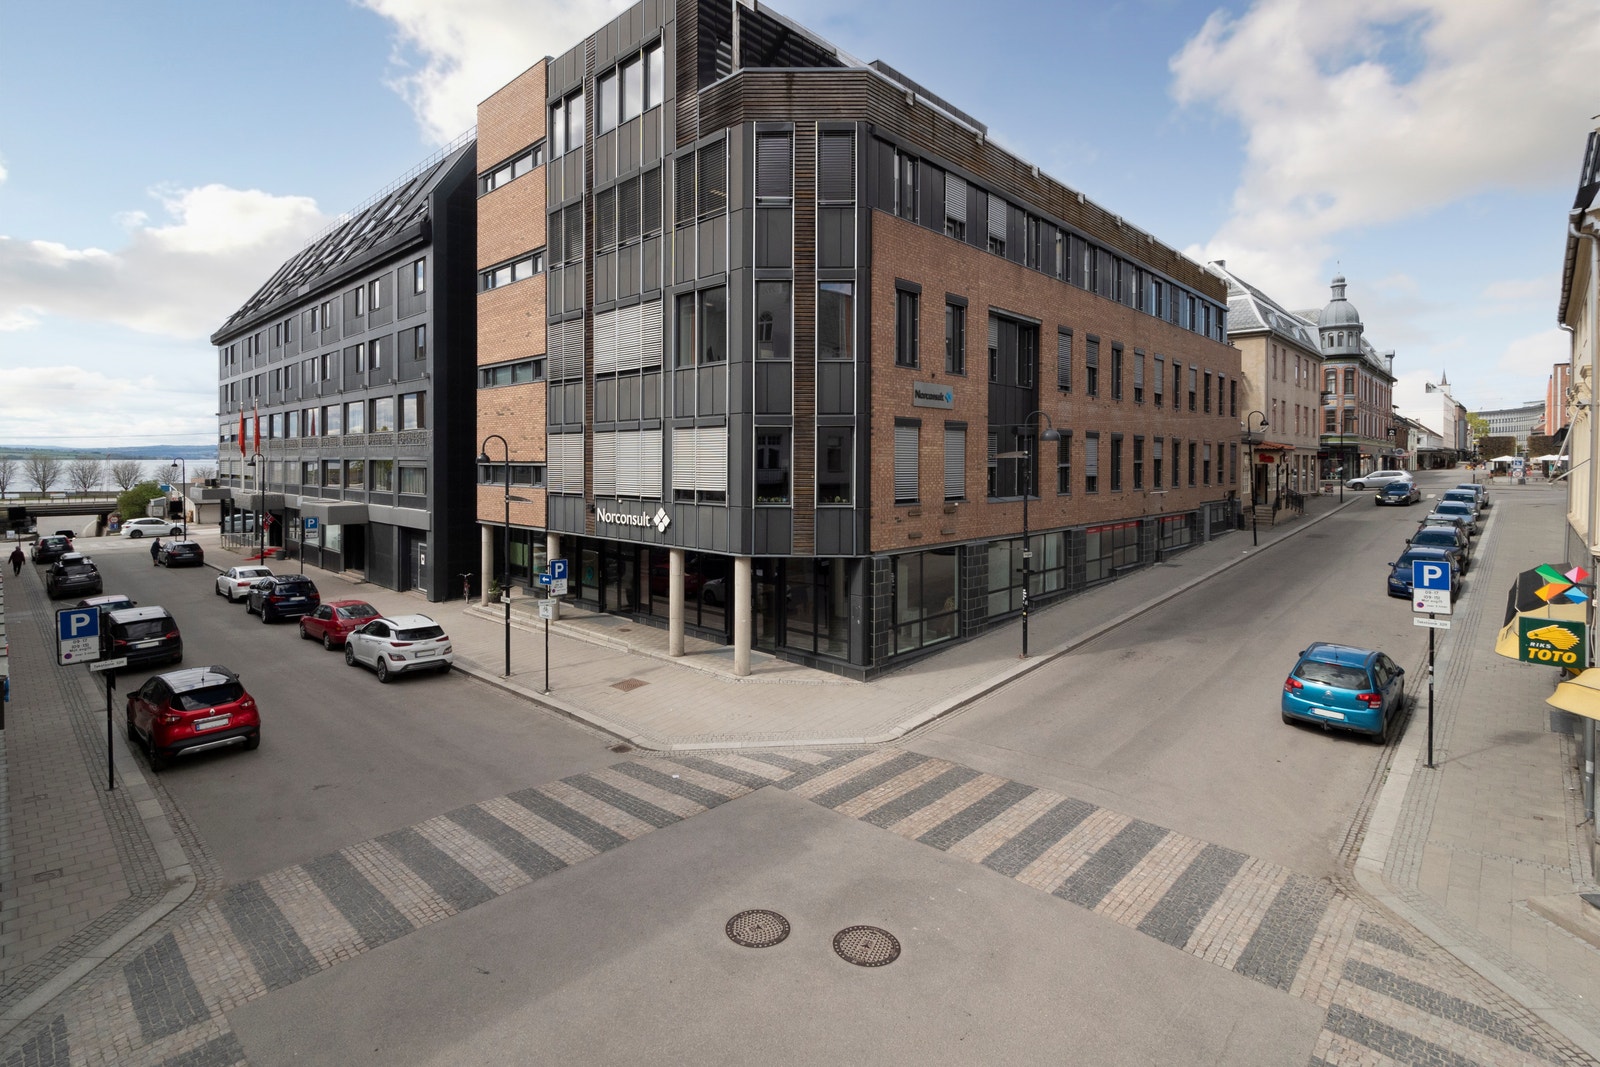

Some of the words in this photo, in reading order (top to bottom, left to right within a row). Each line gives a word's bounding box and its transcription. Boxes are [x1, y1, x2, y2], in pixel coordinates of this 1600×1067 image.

[308, 519, 315, 527] P
[597, 507, 650, 527] Norconsult
[555, 562, 564, 578] P
[1423, 565, 1442, 587] P
[70, 613, 90, 636] P
[1528, 647, 1577, 664] TOTO
